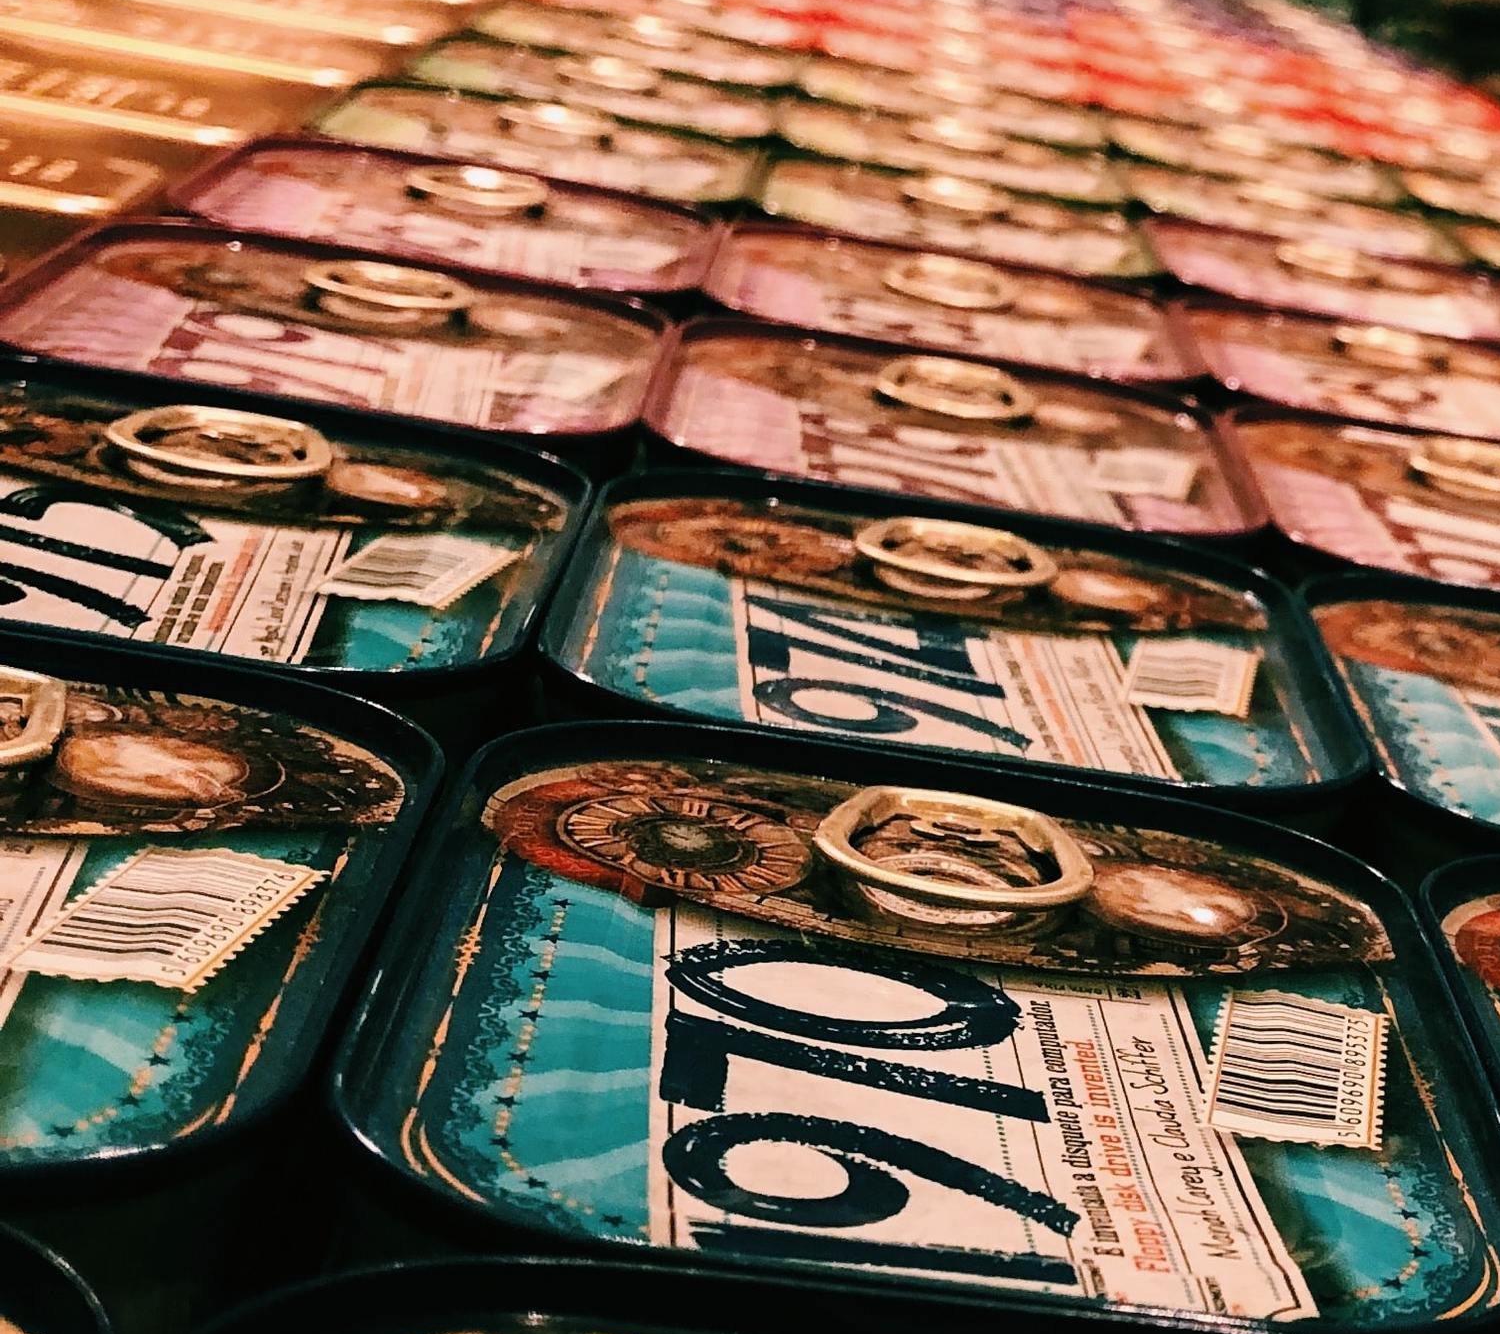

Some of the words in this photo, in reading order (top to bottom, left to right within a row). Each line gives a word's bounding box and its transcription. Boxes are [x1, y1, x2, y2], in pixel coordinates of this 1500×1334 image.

[745, 593, 1032, 751] 974
[1064, 1038, 1111, 1108] invented.
[1116, 1035, 1168, 1095] Schiffer
[662, 937, 1081, 1285] 1970
[1049, 1077, 1083, 1109] para
[1054, 1111, 1093, 1168] disquete
[1089, 1114, 1117, 1129] is
[1133, 1099, 1190, 1148] Claudia
[1098, 1134, 1132, 1177] drive
[1173, 1152, 1196, 1162] e
[1106, 1183, 1147, 1212] disk
[1176, 1166, 1223, 1207] Carey
[1130, 1217, 1170, 1273] Floppy
[1176, 1209, 1242, 1259] Mariah
